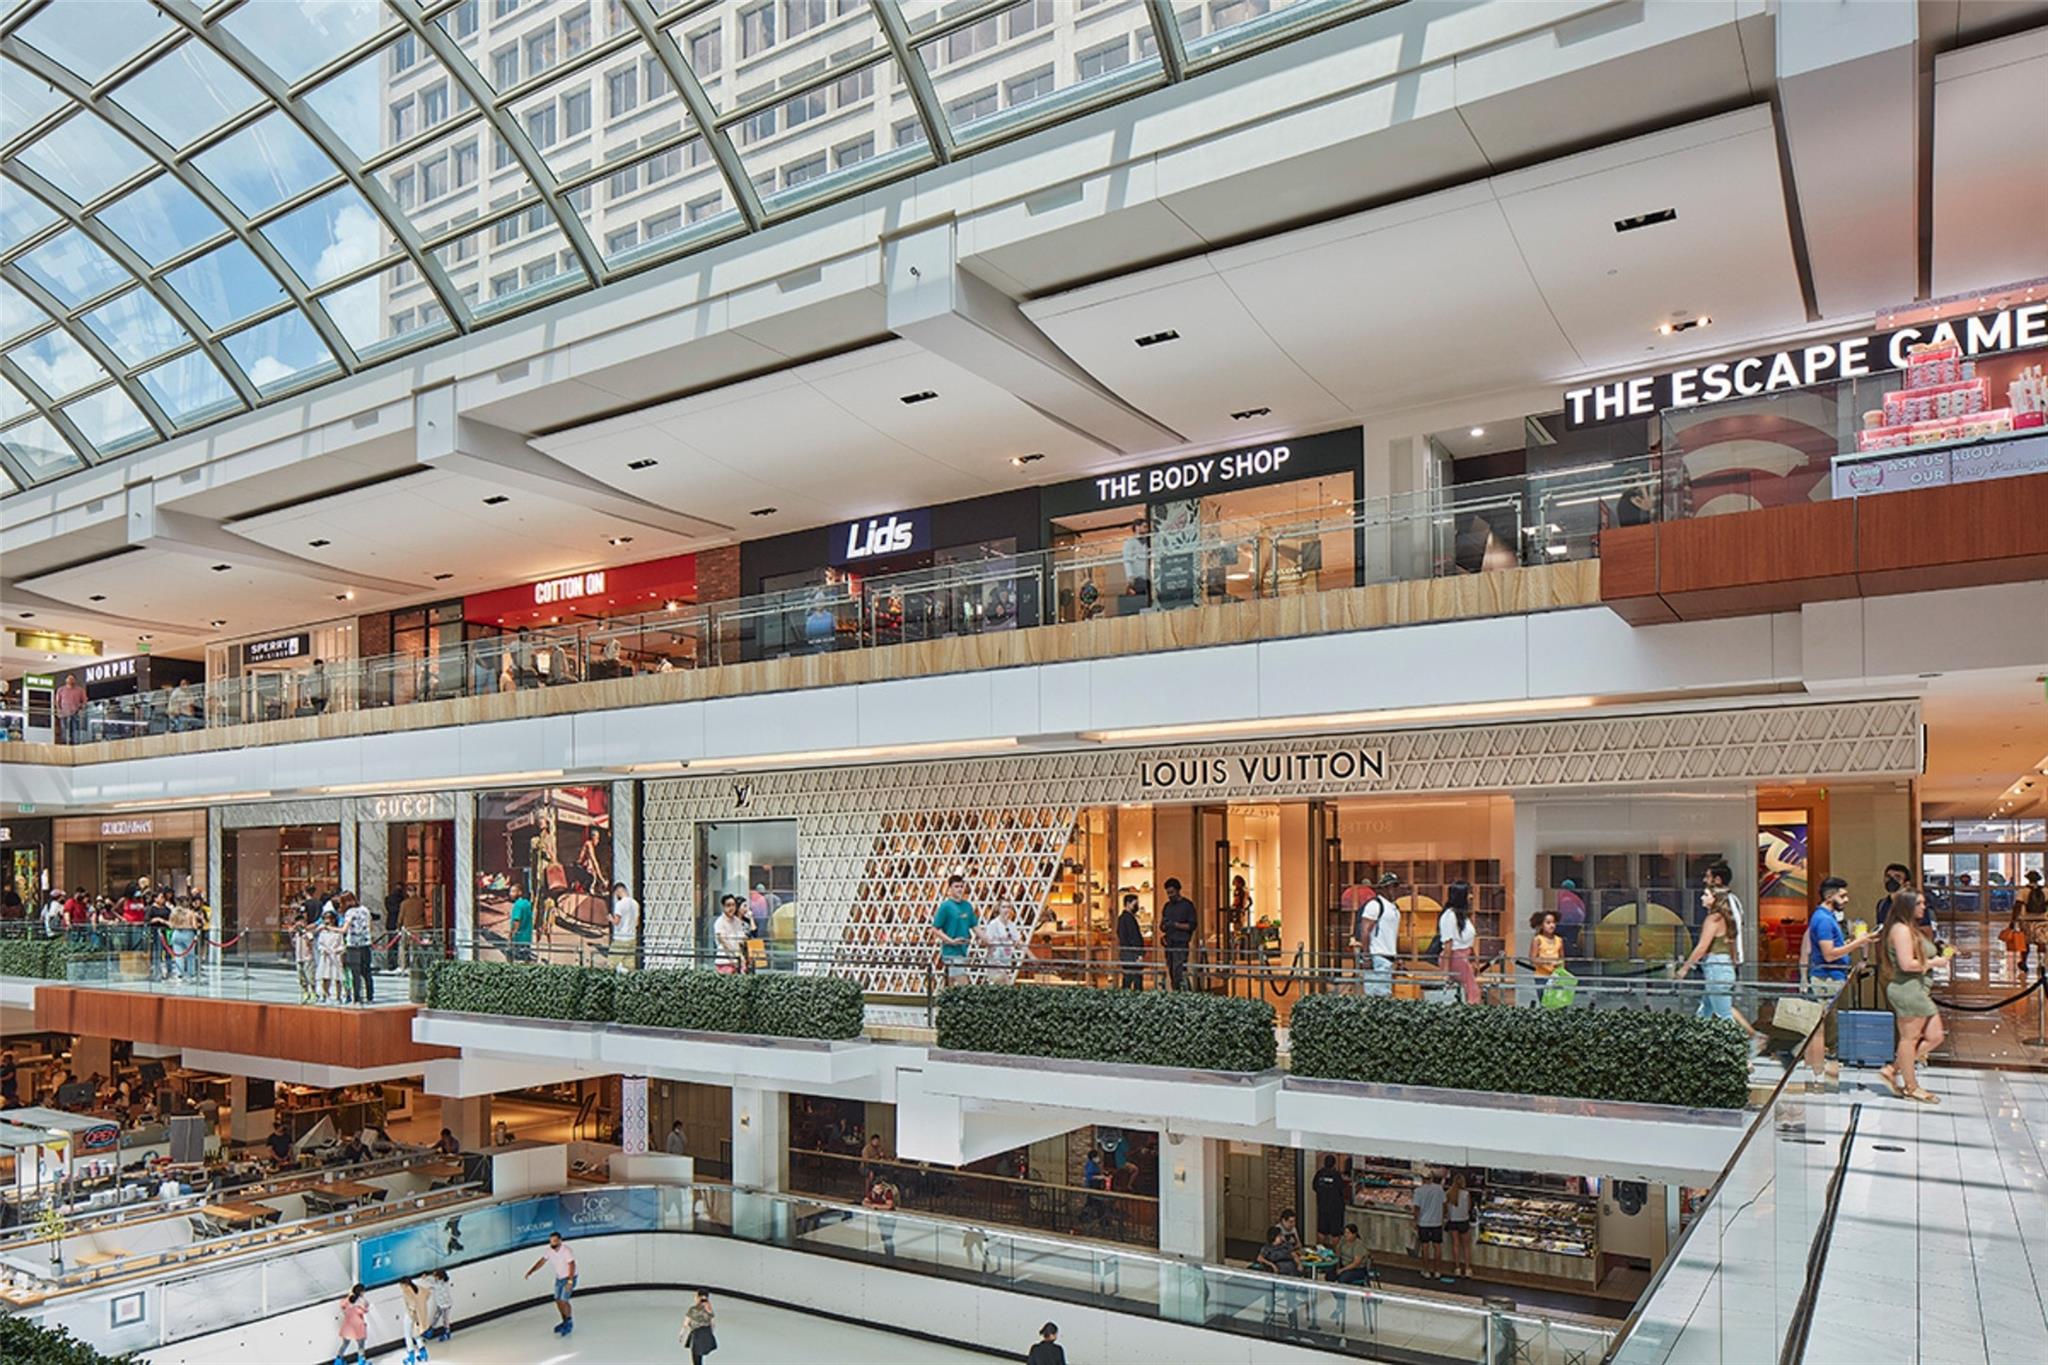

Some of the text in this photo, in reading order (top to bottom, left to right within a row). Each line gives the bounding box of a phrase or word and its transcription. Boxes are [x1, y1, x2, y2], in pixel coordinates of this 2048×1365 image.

[1566, 305, 2048, 424] THE ESCAPE GAME
[1096, 446, 1290, 501] THE BODY SHOP
[1888, 444, 2006, 472] ASK US ABOUT
[1910, 469, 1944, 483] OUR
[846, 516, 913, 559] Lids
[535, 571, 605, 605] COTTON ON
[251, 640, 290, 655] SPERRY
[1141, 749, 1384, 787] LOUIS VUITTON
[375, 796, 435, 818] GUCCI
[86, 1130, 117, 1143] OPEN
